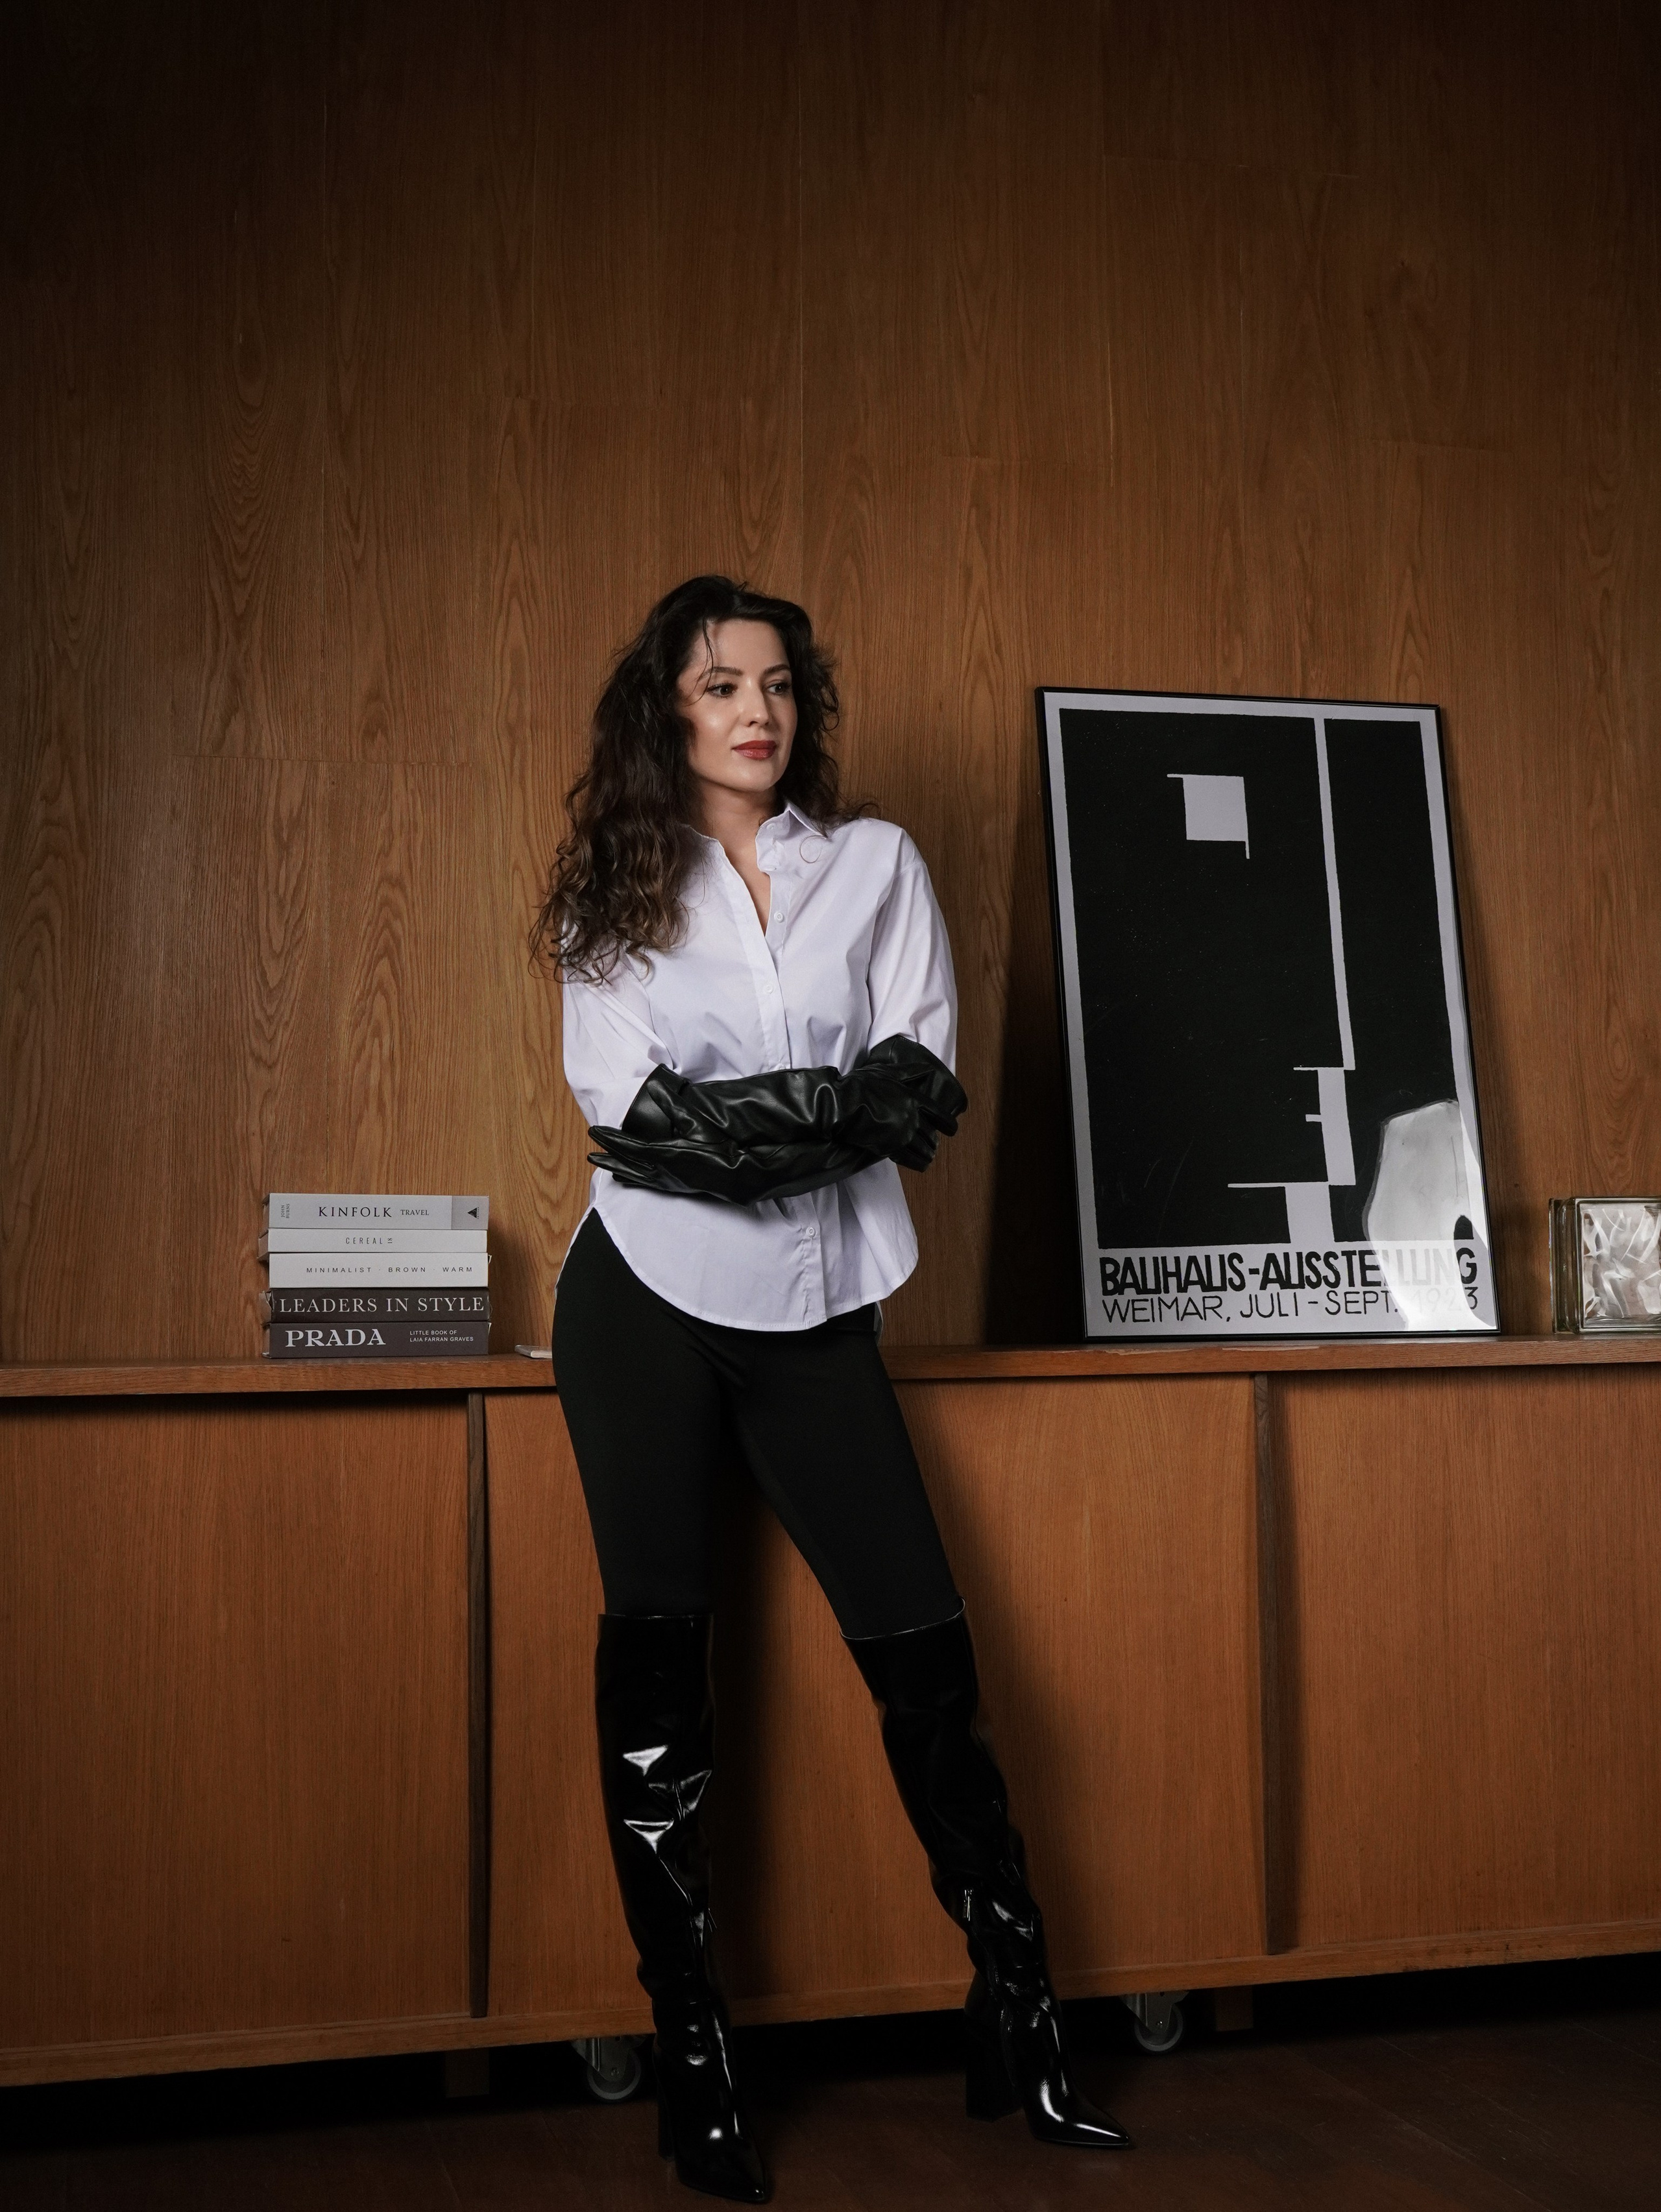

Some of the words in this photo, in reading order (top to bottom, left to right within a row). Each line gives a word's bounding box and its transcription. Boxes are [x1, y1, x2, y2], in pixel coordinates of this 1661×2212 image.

[319, 1206, 392, 1218] KINFOLK
[279, 1298, 377, 1313] LEADERS
[387, 1298, 409, 1312] IN
[418, 1297, 484, 1312] STYLE
[1102, 1295, 1231, 1323] WEIMAR,
[1239, 1292, 1299, 1318] JULI
[1325, 1290, 1398, 1316] SEPT.
[285, 1328, 386, 1347] PRADA
